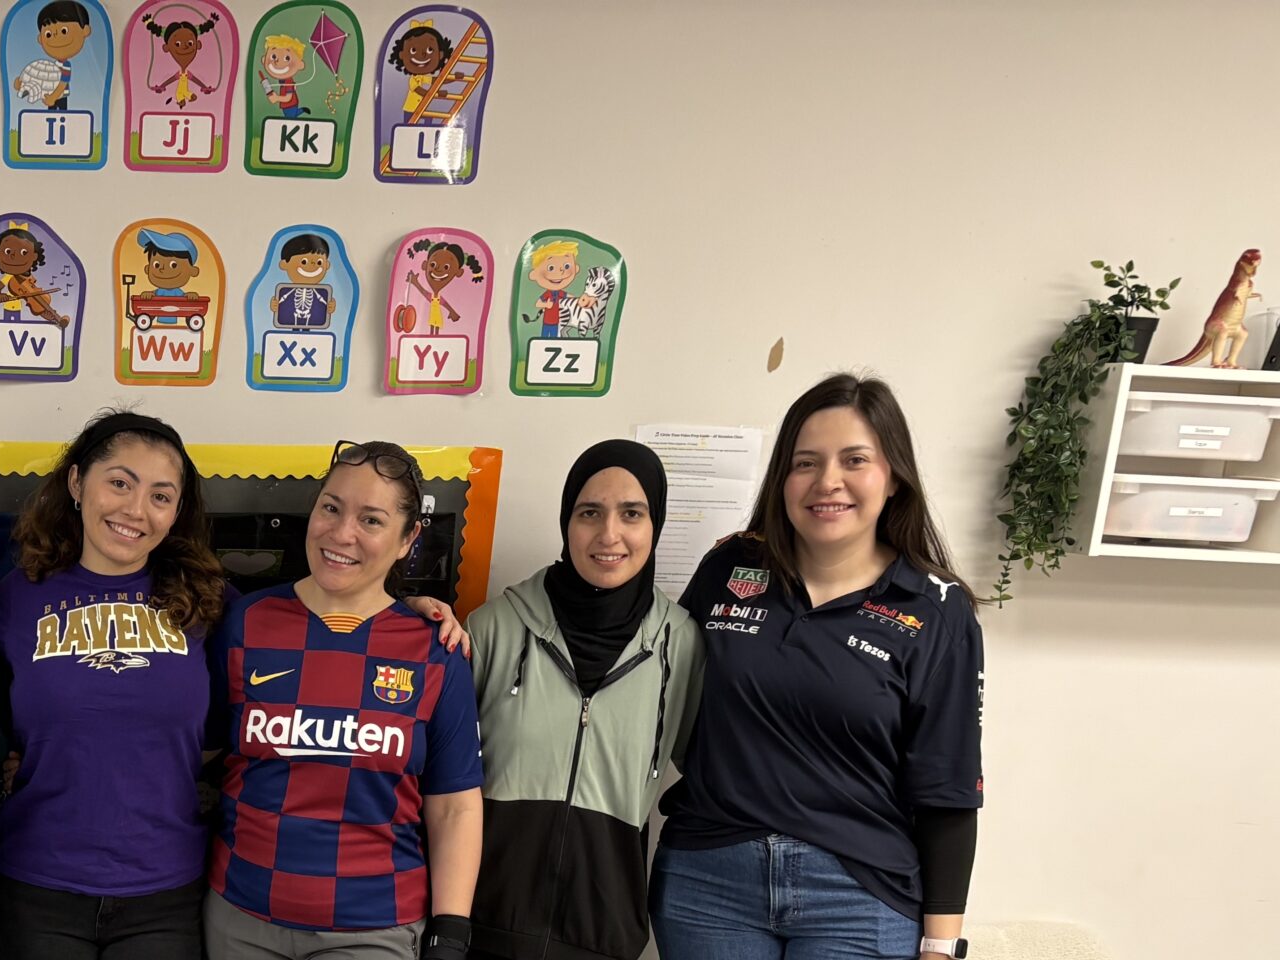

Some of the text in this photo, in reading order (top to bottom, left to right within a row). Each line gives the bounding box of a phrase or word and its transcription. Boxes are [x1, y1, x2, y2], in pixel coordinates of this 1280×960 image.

[45, 116, 66, 146] Ii
[162, 118, 190, 156] Jj
[279, 123, 319, 154] Kk
[8, 329, 47, 357] Vv
[136, 334, 195, 362] Ww
[276, 340, 317, 368] Xx
[413, 344, 450, 378] Yy
[541, 346, 581, 373] Zz
[44, 592, 151, 614] BALTIMO
[710, 603, 751, 619] Mobil
[862, 600, 898, 618] Red Bull
[32, 602, 189, 662] RAVENS
[705, 621, 760, 635] ORACLE
[856, 609, 919, 638] RACING
[859, 640, 891, 662] Tezos
[245, 708, 405, 758] Rakuten
